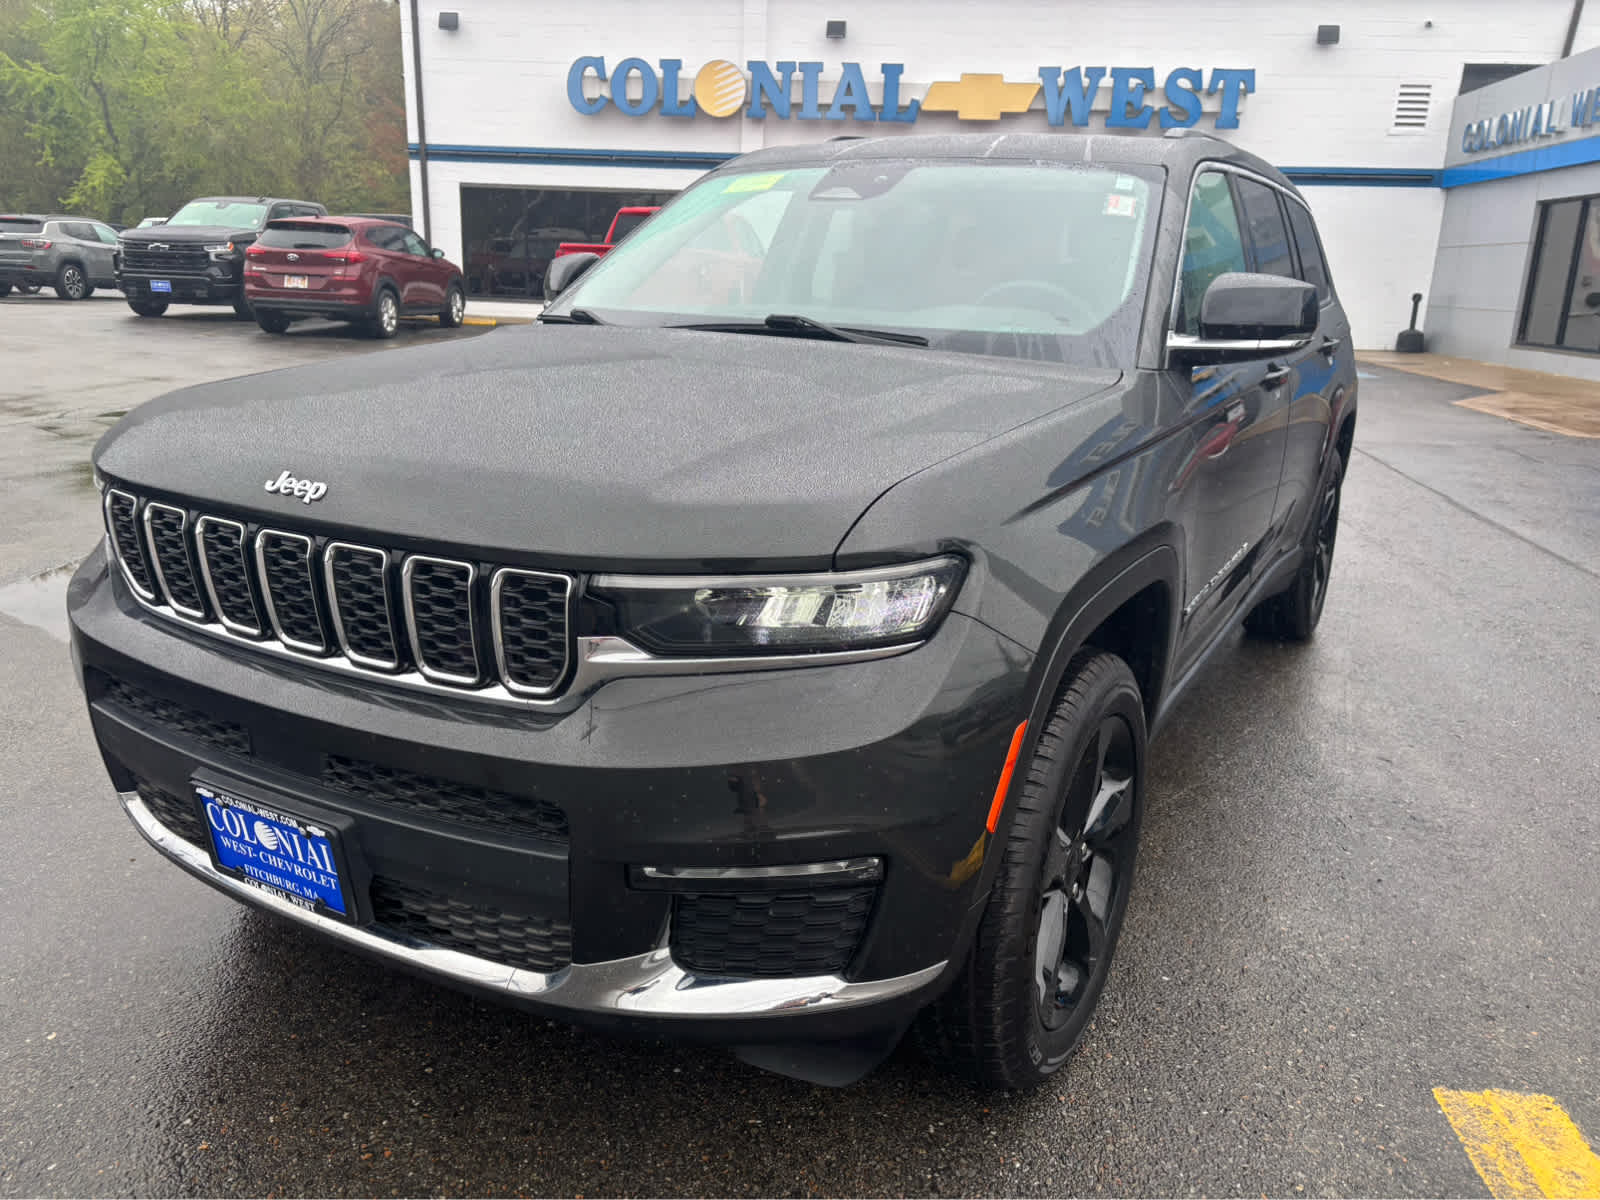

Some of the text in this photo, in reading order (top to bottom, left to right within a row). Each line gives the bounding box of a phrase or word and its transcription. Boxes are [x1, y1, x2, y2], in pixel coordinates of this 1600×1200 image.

[567, 55, 1256, 130] COLONIAL WEST
[1461, 99, 1564, 153] COLONIAL
[264, 470, 328, 504] Jeep
[206, 802, 338, 876] COLONIAL
[259, 851, 337, 890] CHEVROLET
